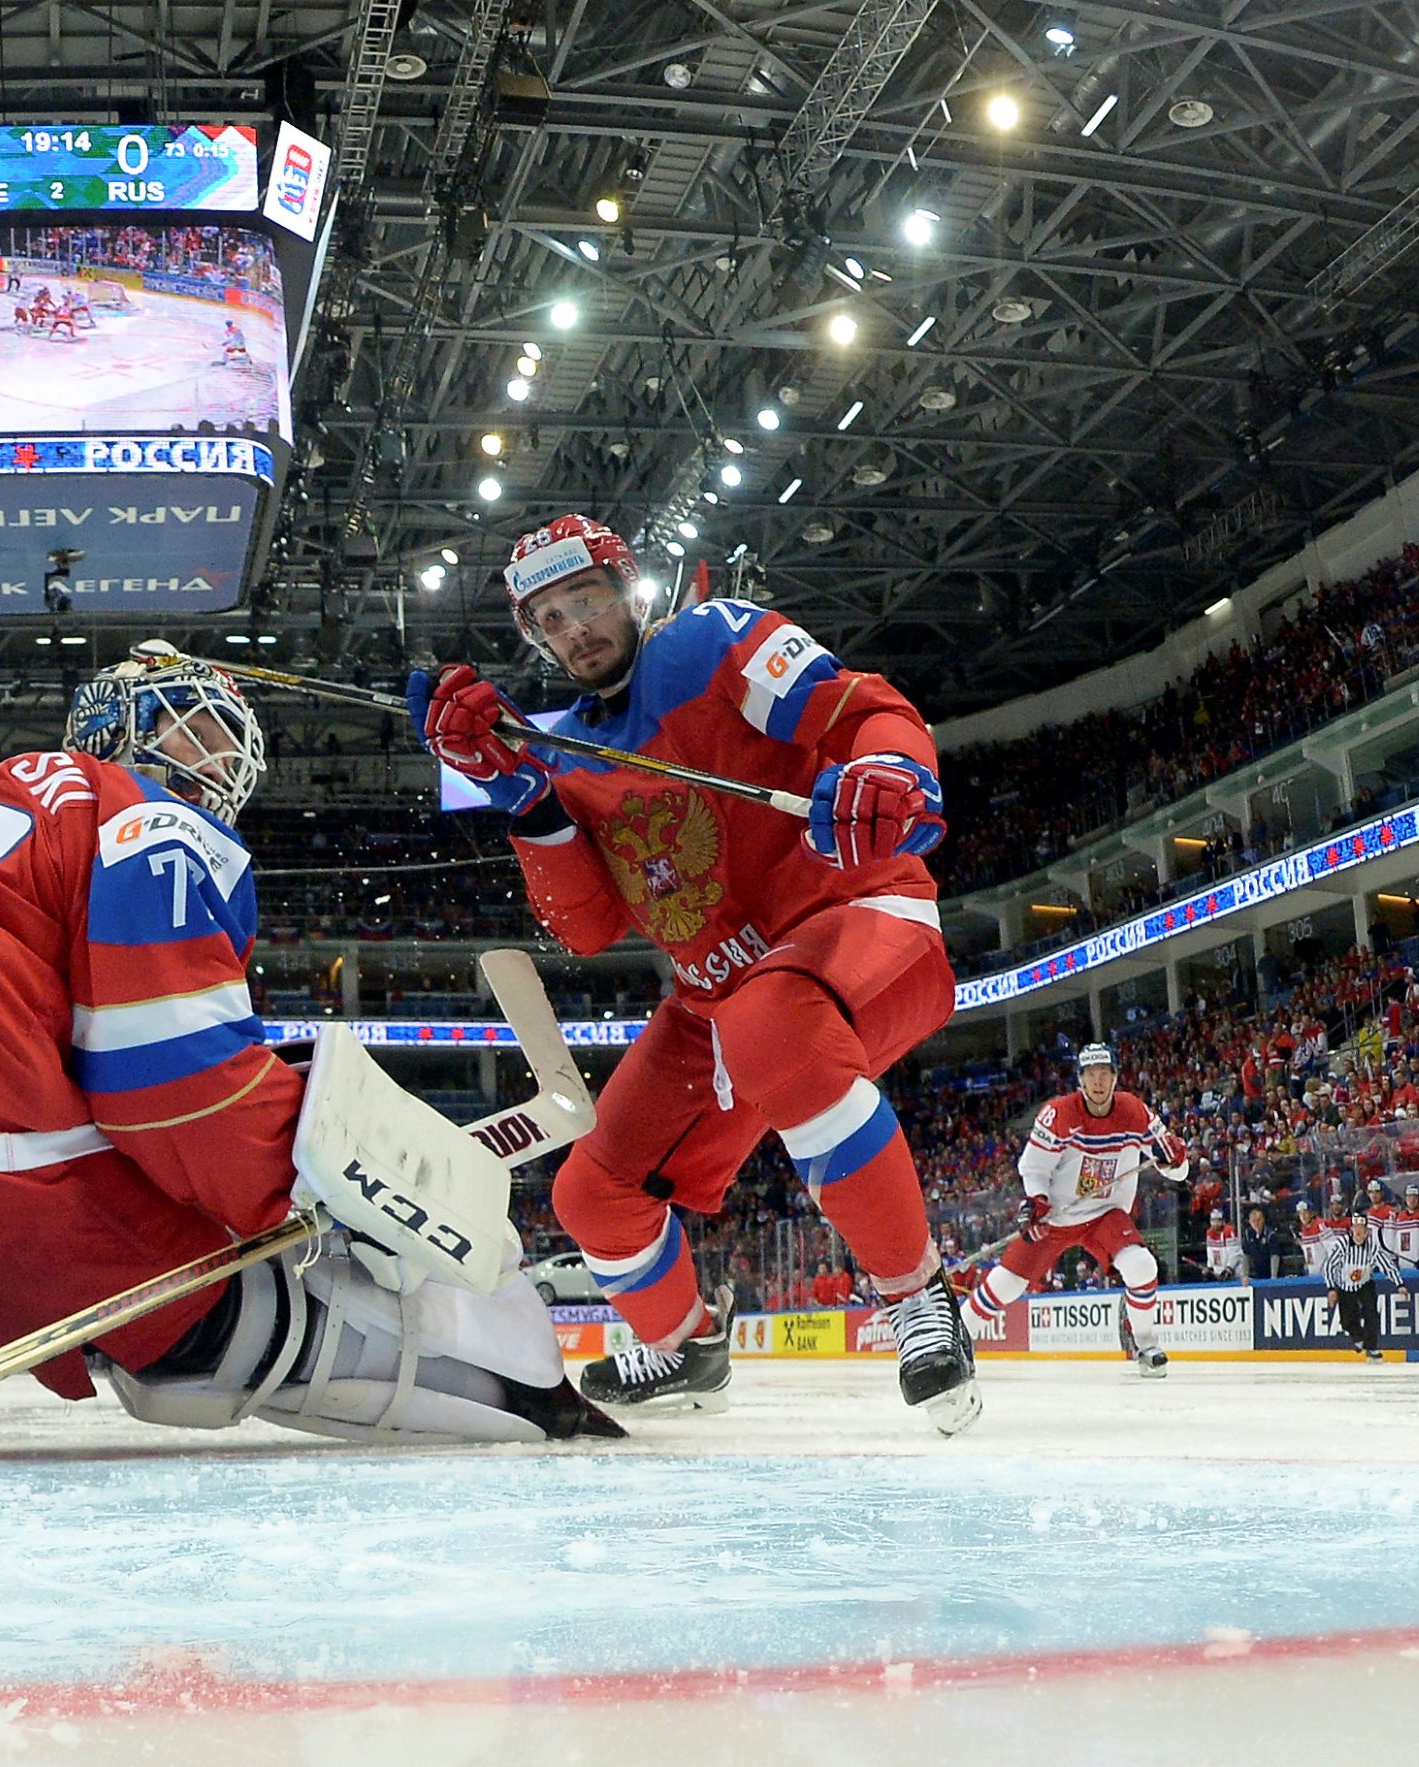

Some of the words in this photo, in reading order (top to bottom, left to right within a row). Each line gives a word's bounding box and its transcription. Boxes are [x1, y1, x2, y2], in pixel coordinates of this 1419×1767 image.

[21, 131, 91, 152] 19:14
[116, 134, 149, 175] 0
[50, 182, 64, 199] 2
[108, 181, 165, 202] RUS
[84, 442, 257, 476] РОССИЯ
[108, 505, 242, 525] ПАРК
[10, 751, 98, 816] SKI
[1233, 856, 1314, 904] РОССИЯ
[1086, 920, 1147, 967] РОССИЯ
[1286, 916, 1314, 944] 305
[343, 1158, 475, 1267] CCM
[1053, 1303, 1112, 1328] TISSOT
[1176, 1296, 1251, 1325] TISSOT
[1263, 1296, 1350, 1339] NIVEA
[796, 1335, 818, 1352] BANK
